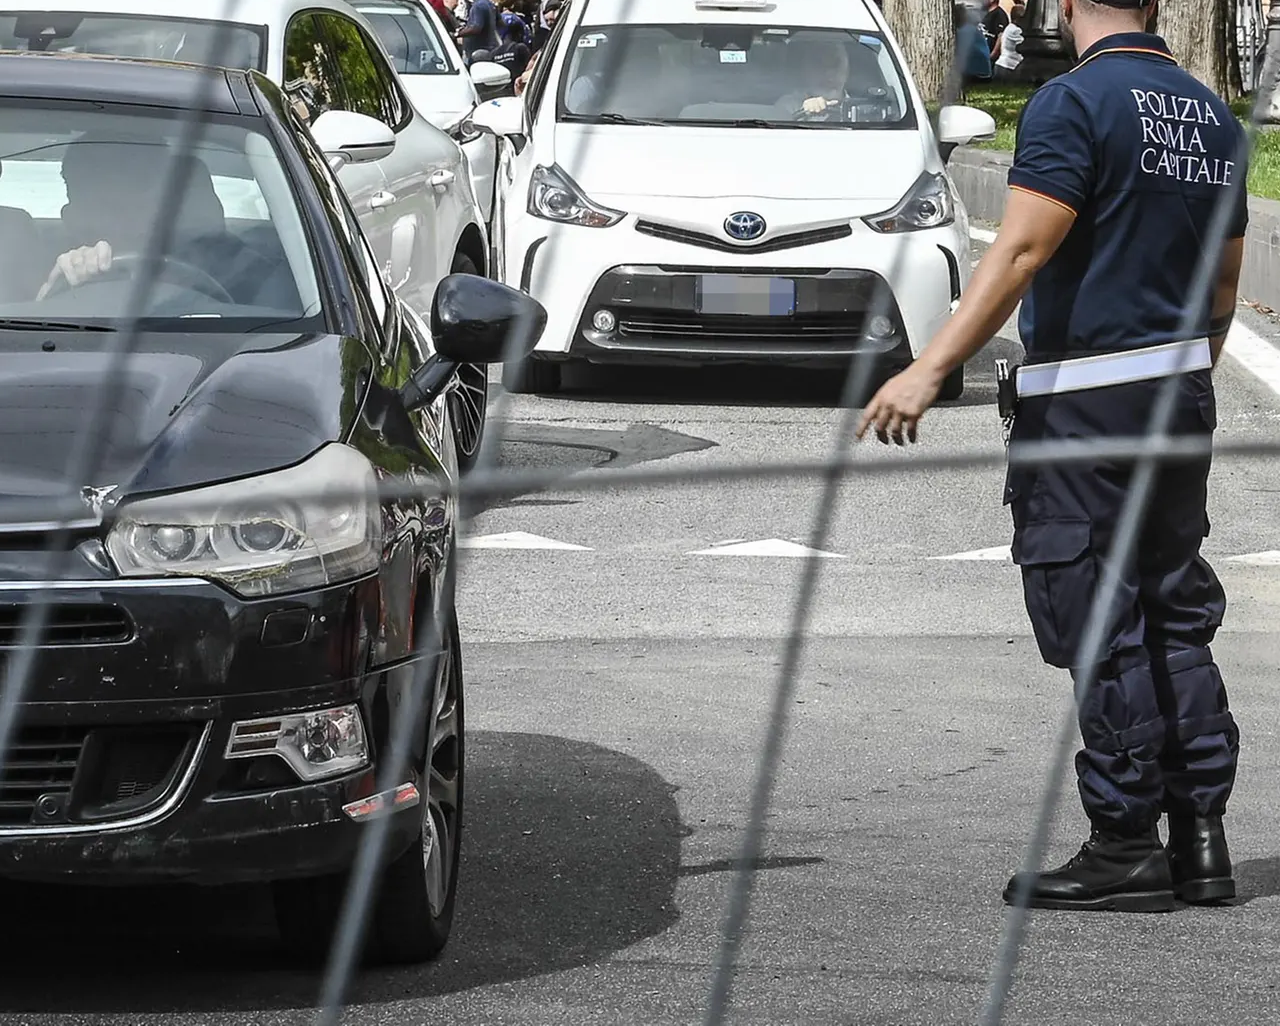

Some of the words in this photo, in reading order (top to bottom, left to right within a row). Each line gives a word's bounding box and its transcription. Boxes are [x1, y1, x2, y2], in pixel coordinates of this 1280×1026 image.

[1130, 88, 1221, 126] POLIZIA
[1140, 116, 1208, 153] ROMA
[1140, 147, 1235, 186] CAPITALE
